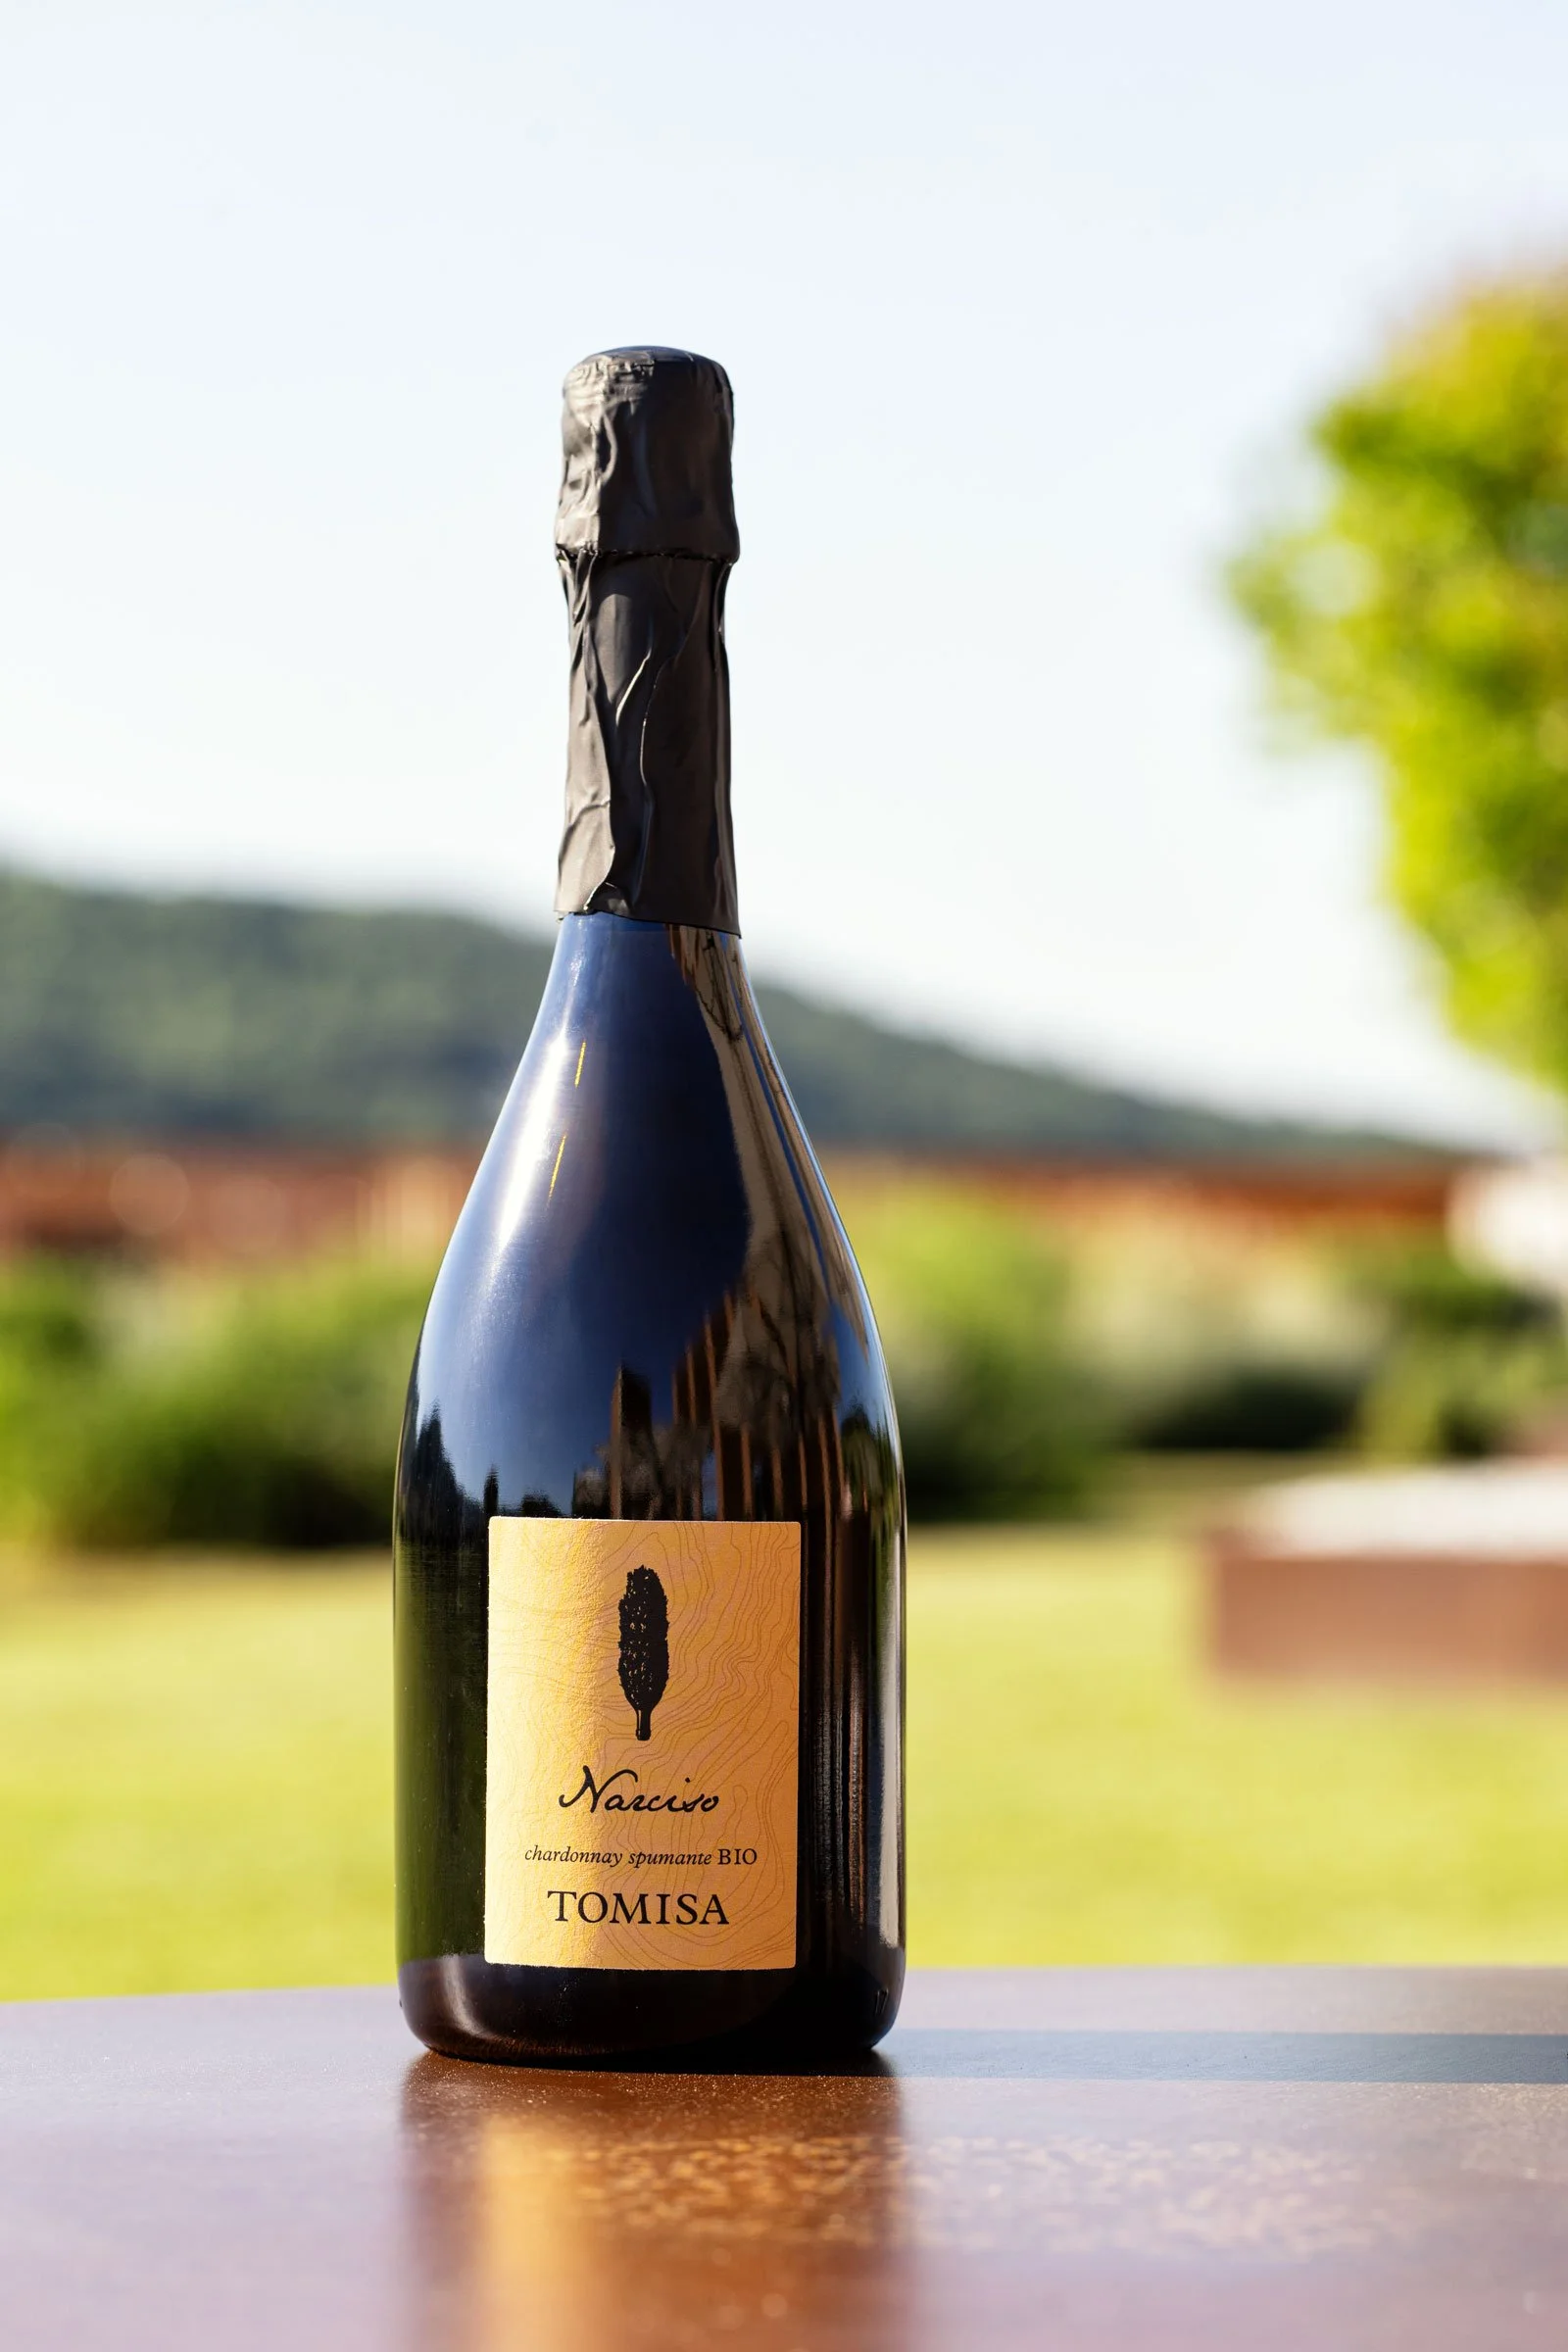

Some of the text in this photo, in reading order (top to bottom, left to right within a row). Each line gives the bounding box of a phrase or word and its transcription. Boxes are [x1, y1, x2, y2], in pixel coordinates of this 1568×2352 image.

[559, 1765, 719, 1814] Narciso
[524, 1844, 758, 1869] chardonnay spumante BIO
[547, 1890, 730, 1926] TOMISA
